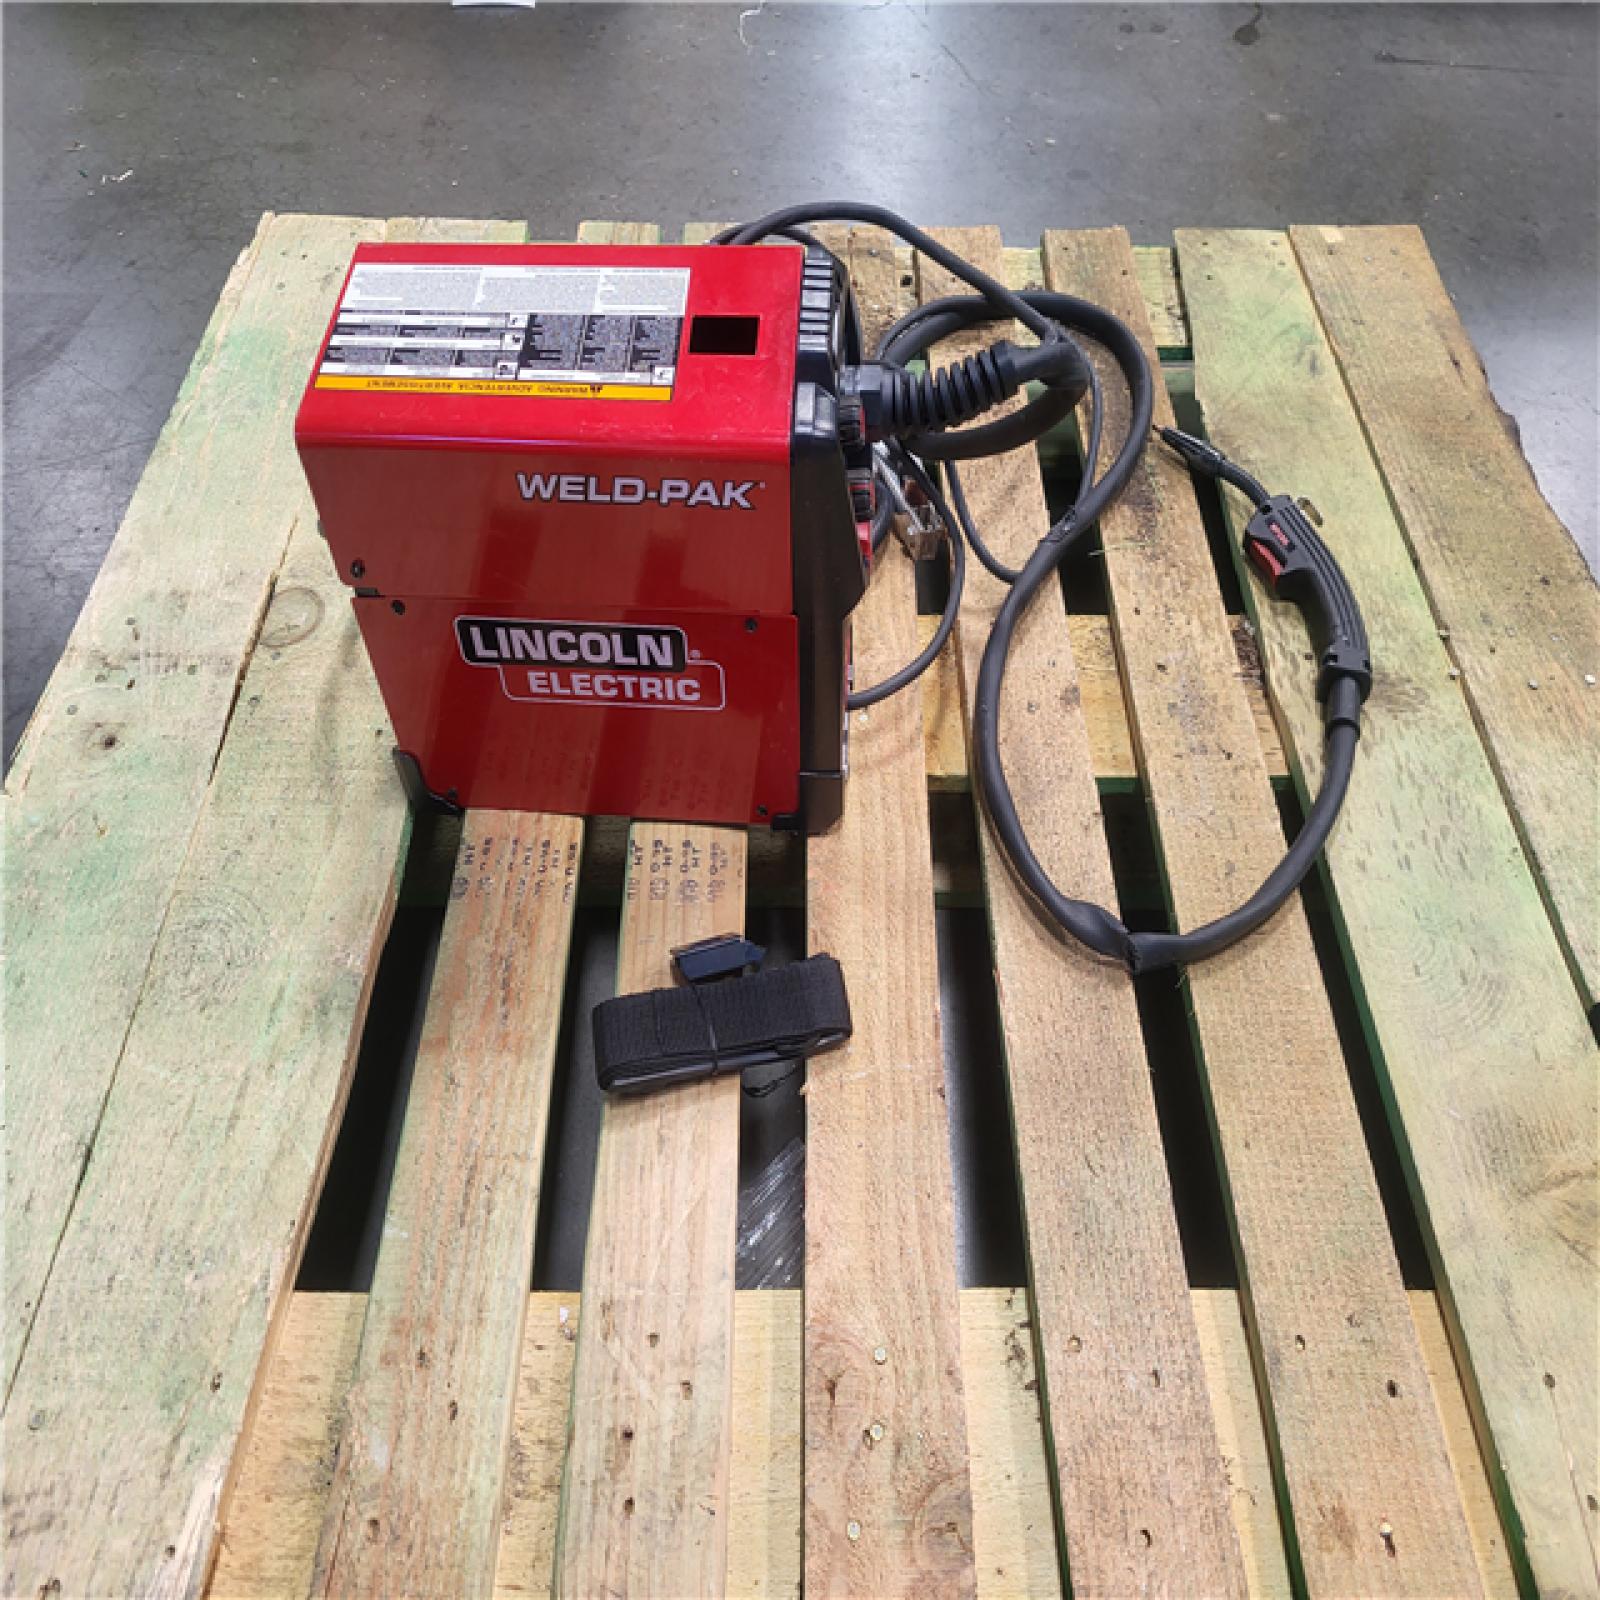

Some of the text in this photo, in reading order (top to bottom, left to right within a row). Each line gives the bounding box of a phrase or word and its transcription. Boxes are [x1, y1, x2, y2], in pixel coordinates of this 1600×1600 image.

[516, 472, 755, 509] WELD-PAK
[469, 626, 674, 667] LINCOLN
[527, 671, 701, 701] ELECTRIC
